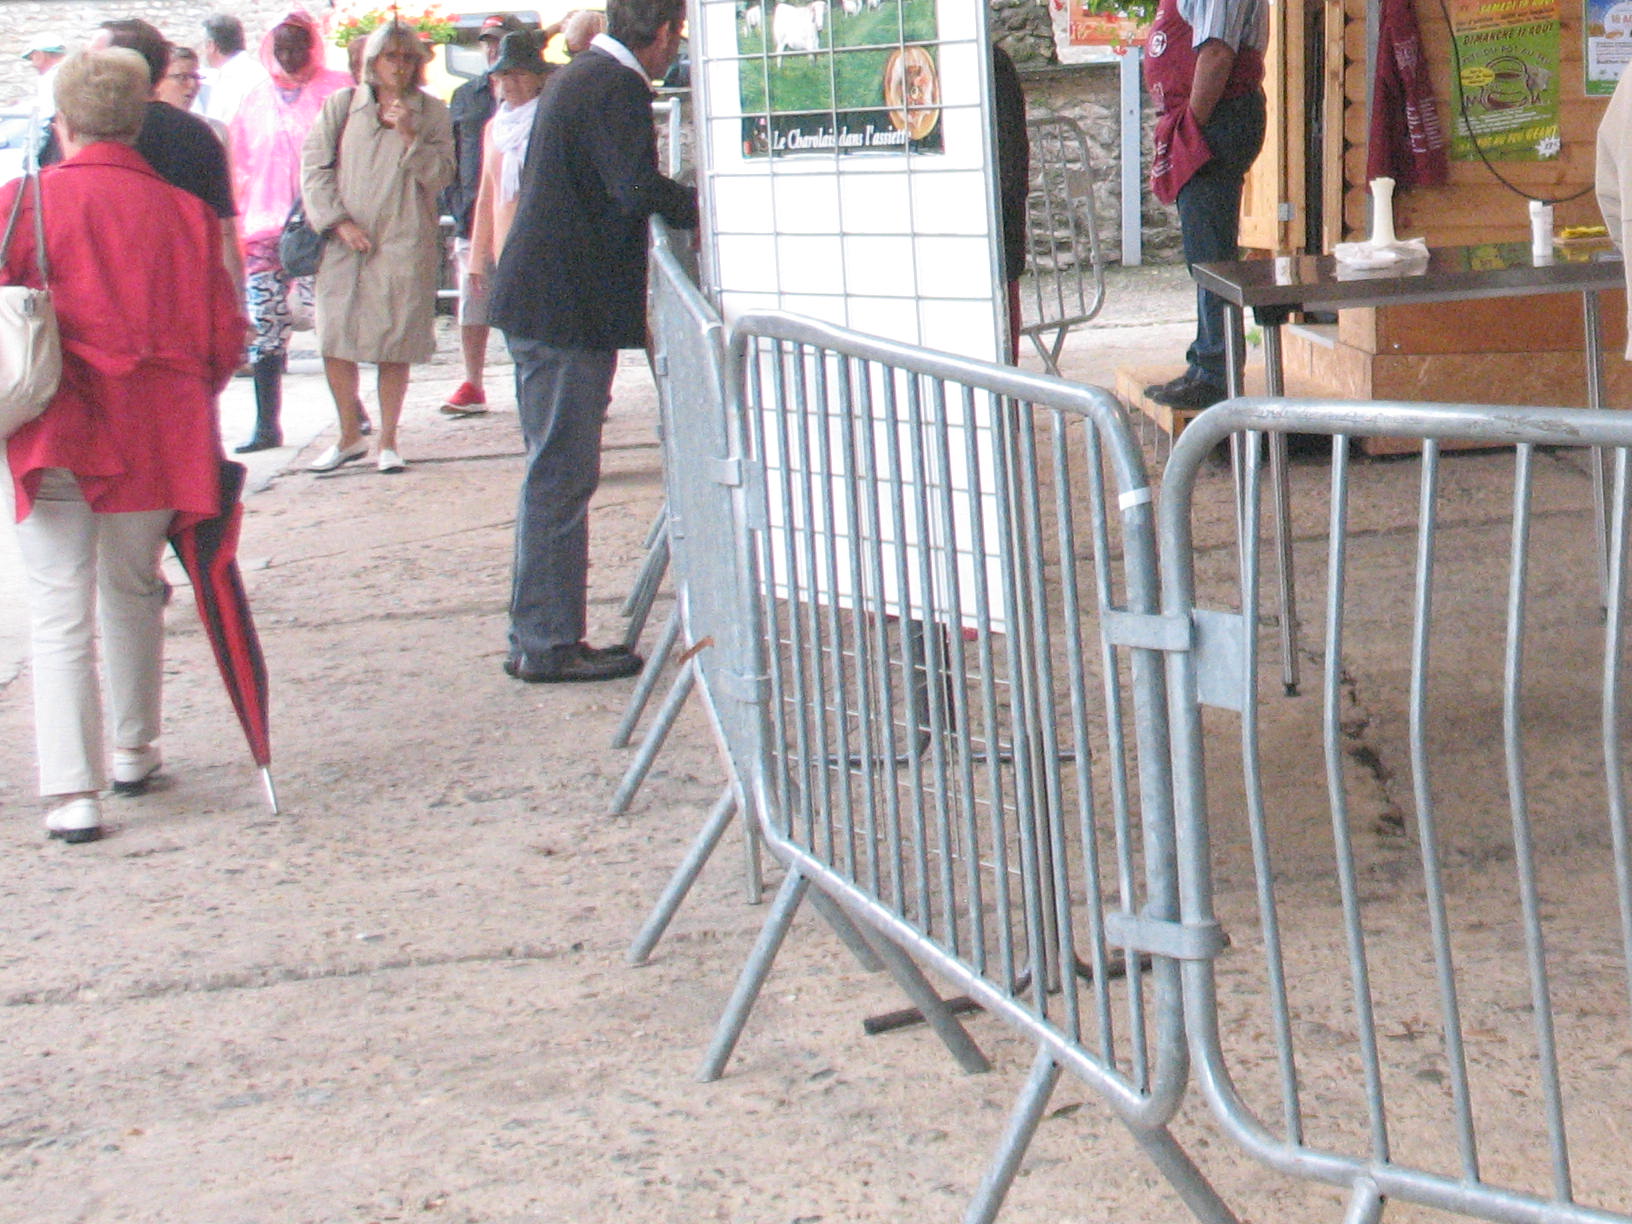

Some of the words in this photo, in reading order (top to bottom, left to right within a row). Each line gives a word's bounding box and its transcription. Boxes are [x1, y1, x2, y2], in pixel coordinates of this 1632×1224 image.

[773, 130, 786, 150] Le
[787, 126, 836, 150] Charolais
[838, 126, 864, 148] dans
